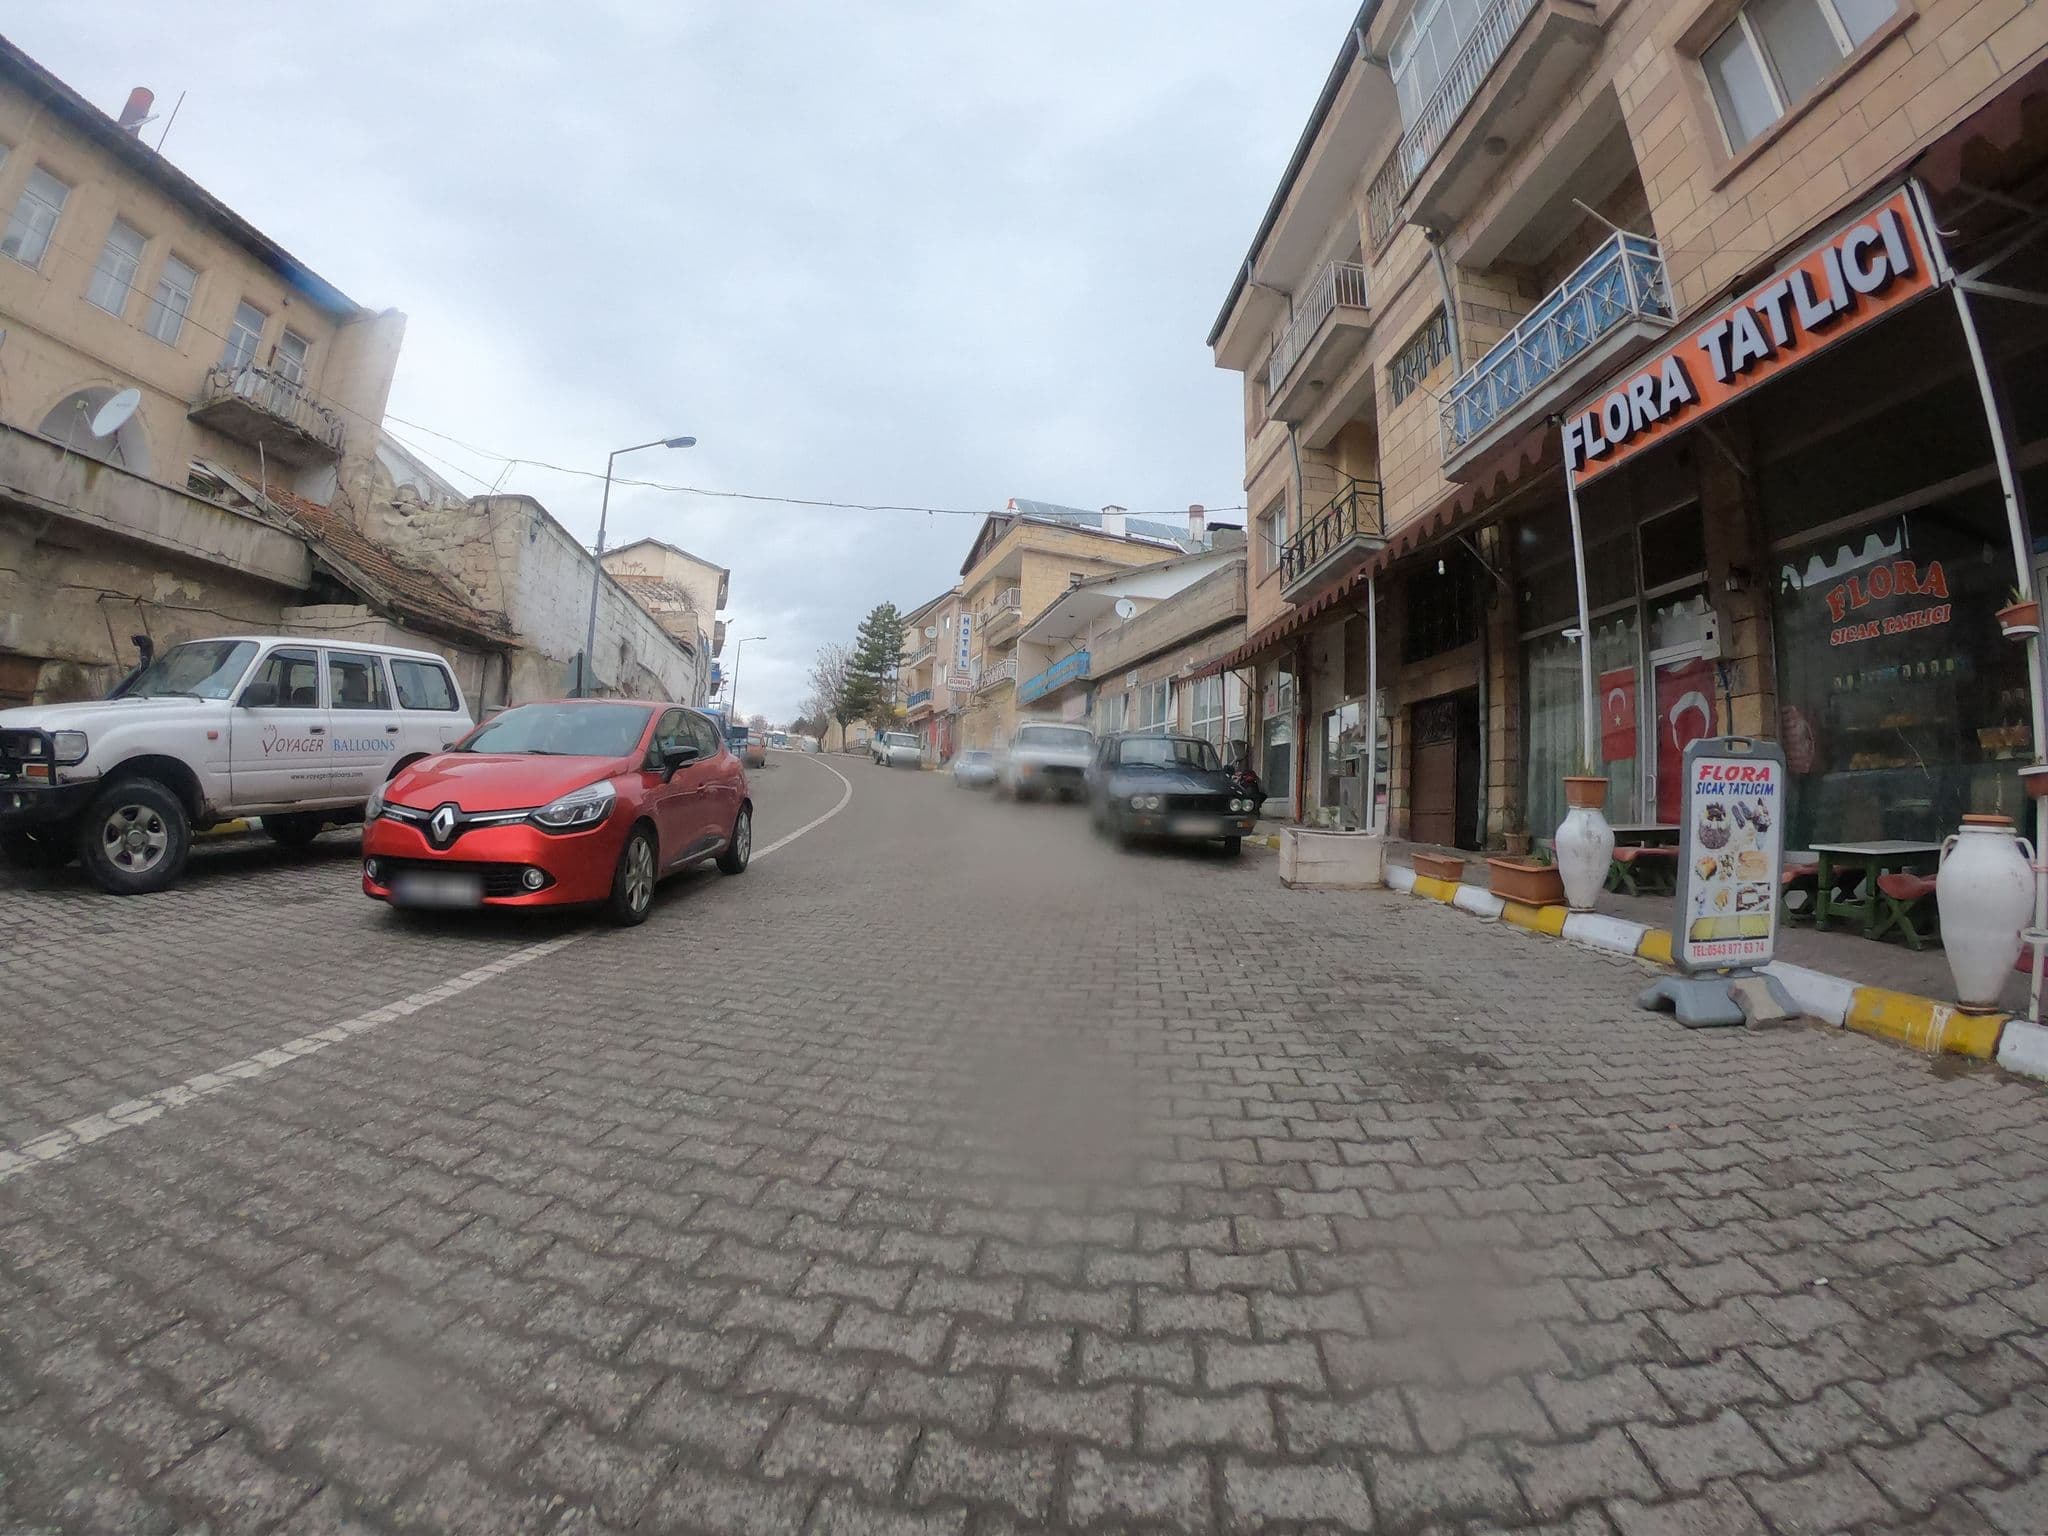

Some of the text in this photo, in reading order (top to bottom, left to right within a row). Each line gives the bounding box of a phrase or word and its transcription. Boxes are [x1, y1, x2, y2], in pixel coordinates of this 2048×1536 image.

[1563, 208, 1914, 471] FLORA TATLICI
[1825, 560, 1949, 623] FLORA
[961, 617, 970, 668] HOTEL
[1830, 603, 1952, 646] SICAK TATLICI
[261, 728, 395, 756] VOYAGER BALLOONS
[1696, 782, 1774, 796] SICAK TATLICIM
[1699, 765, 1770, 782] FLORA
